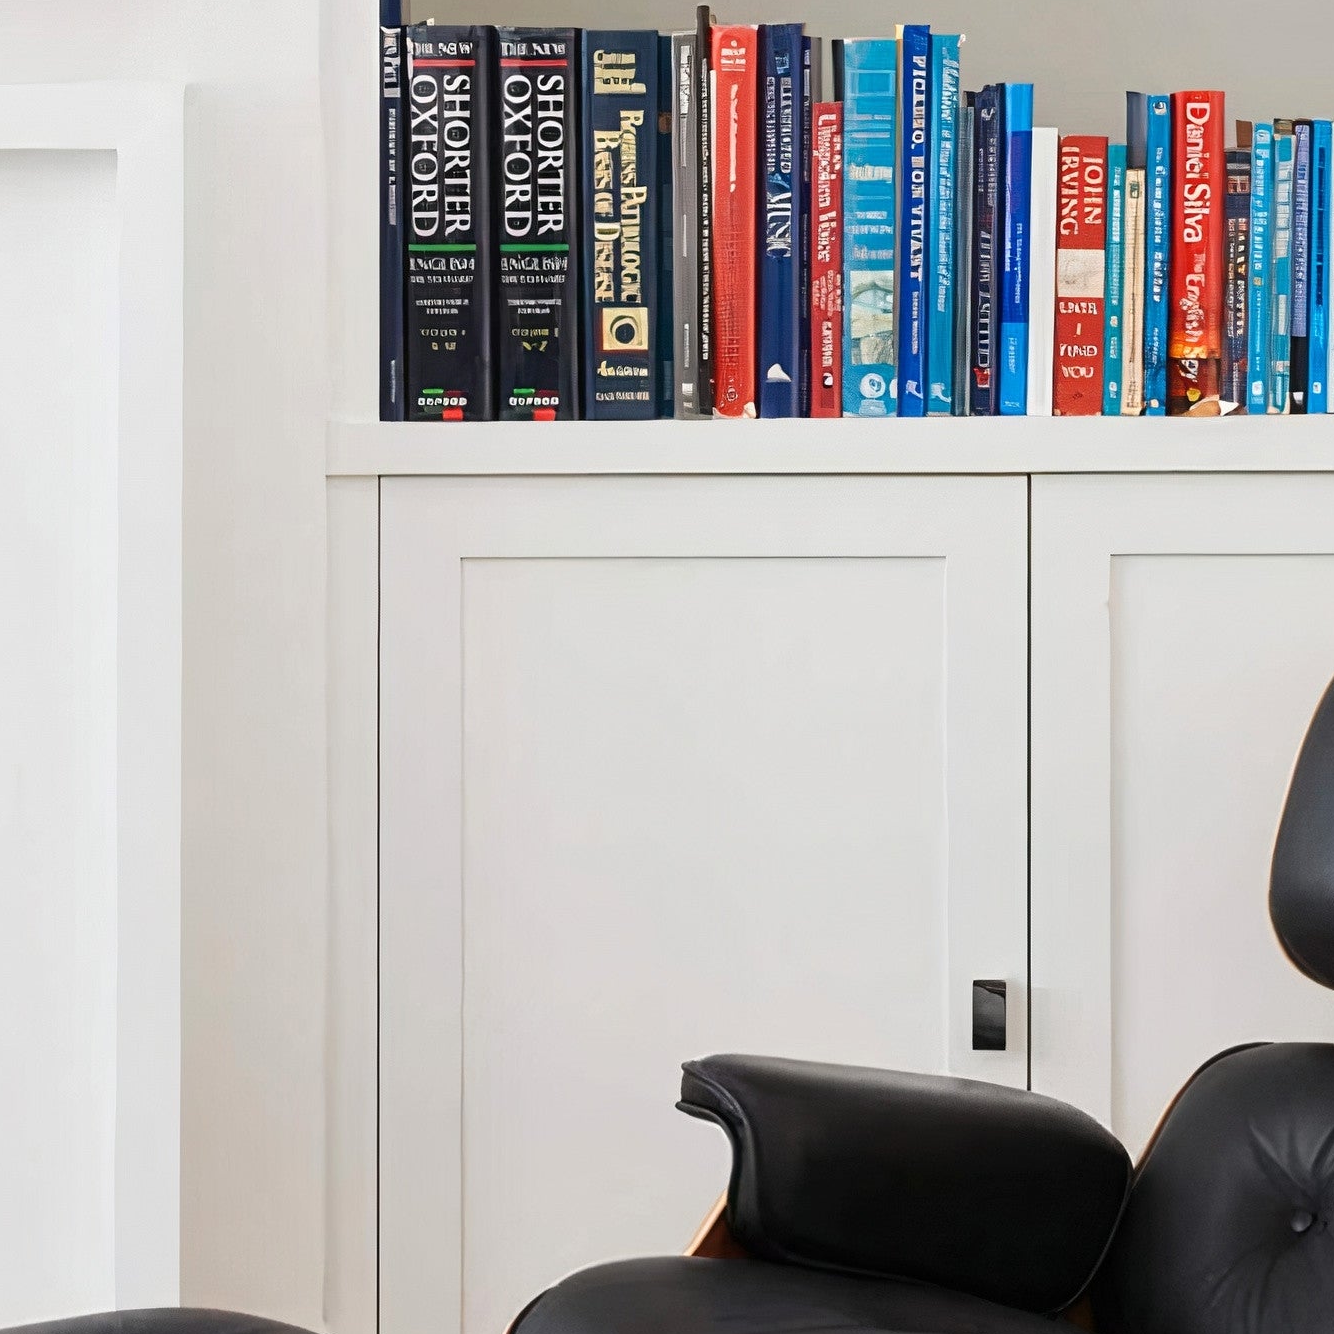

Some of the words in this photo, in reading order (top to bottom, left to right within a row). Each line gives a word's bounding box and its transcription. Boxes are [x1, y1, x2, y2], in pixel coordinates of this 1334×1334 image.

[410, 74, 439, 238] OXFORD
[444, 74, 472, 237] SHORTER
[503, 74, 533, 238] OXFORD
[536, 74, 565, 237] SHORTER
[1059, 146, 1080, 236] IRVING
[1082, 156, 1104, 225] JOHN
[1185, 102, 1211, 178] Daniel
[1183, 183, 1212, 244] Silva
